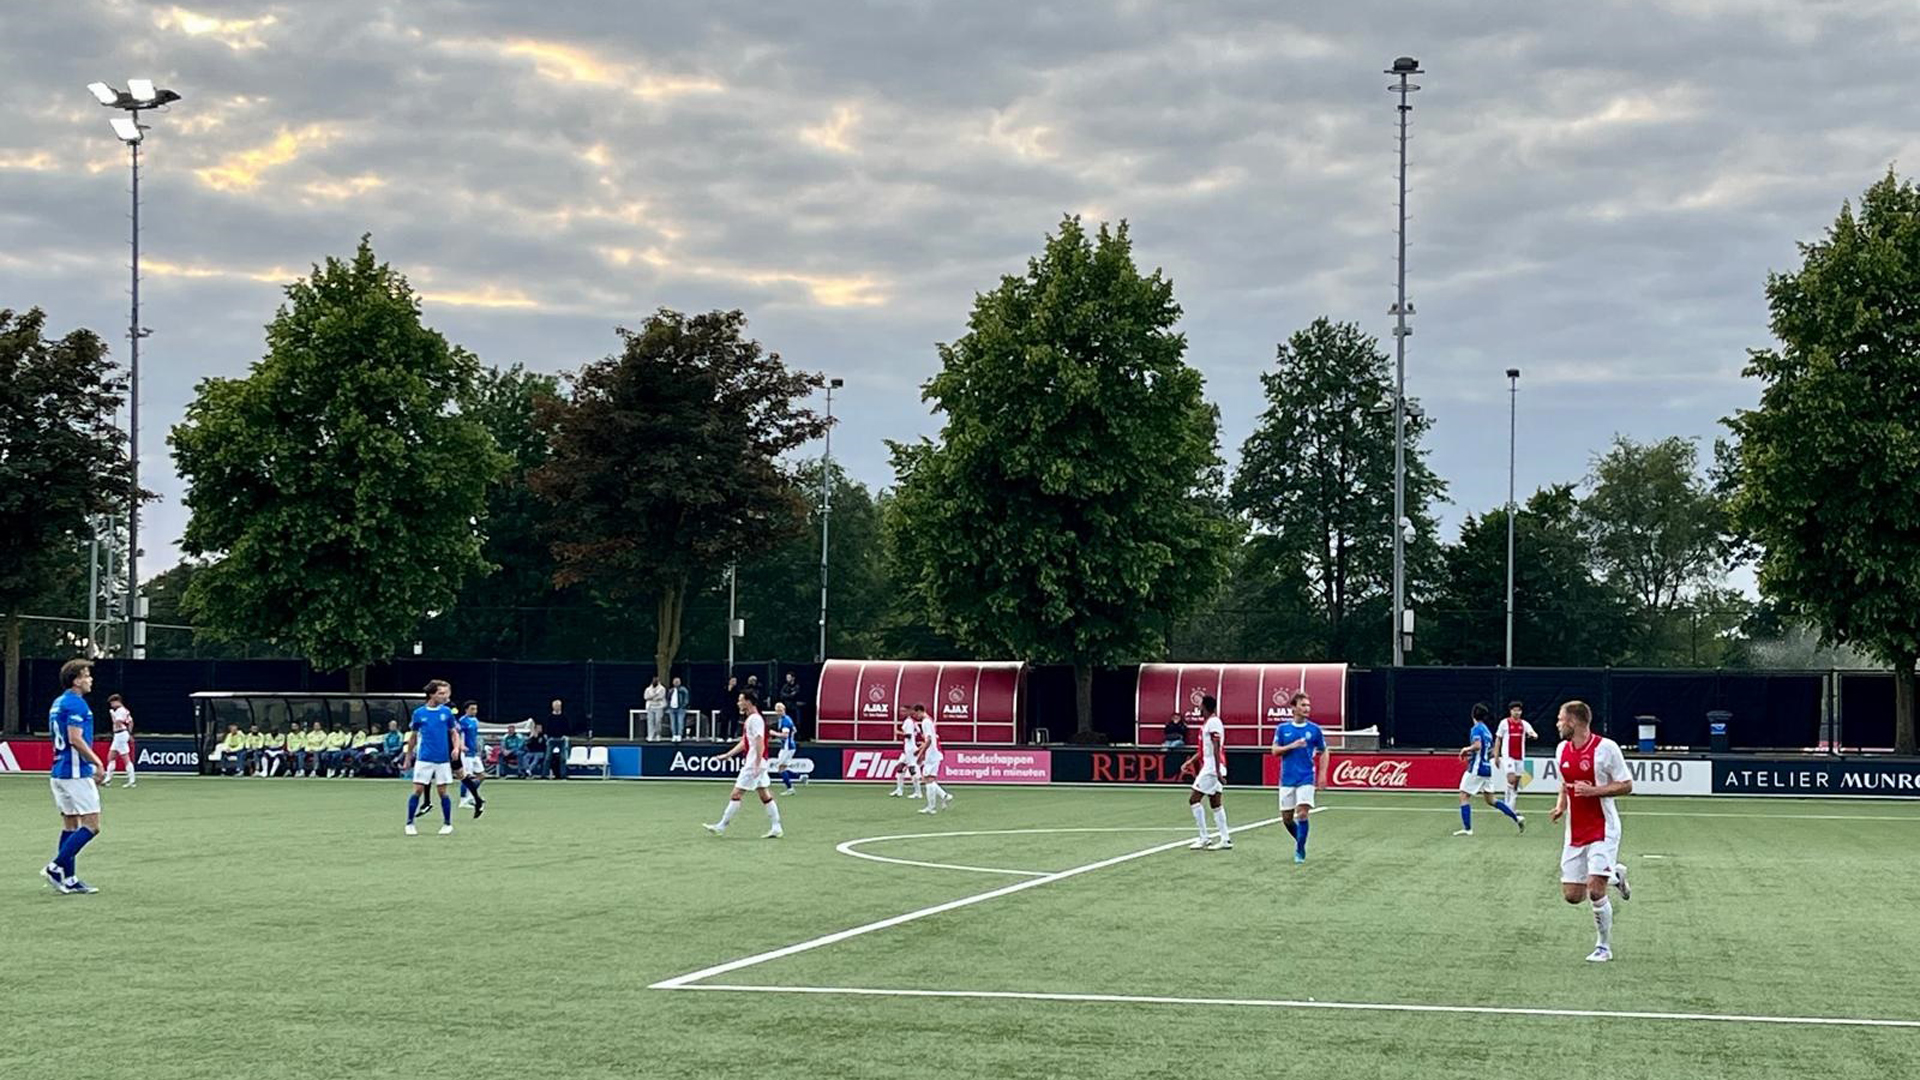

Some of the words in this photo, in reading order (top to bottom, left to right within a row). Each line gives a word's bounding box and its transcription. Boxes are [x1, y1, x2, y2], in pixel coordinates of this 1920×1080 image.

[863, 703, 889, 713] AJAX
[943, 704, 968, 714] AJAX
[1267, 707, 1294, 717] AJAX
[137, 748, 199, 766] Acronis
[957, 753, 1034, 767] Boodschappen
[945, 767, 990, 779] bezorgd
[991, 767, 1001, 777] in
[1003, 768, 1046, 778] minuten
[1091, 753, 1198, 782] REPLA
[1332, 759, 1412, 786] Coca-Cola
[1725, 771, 1829, 787] ATELIER
